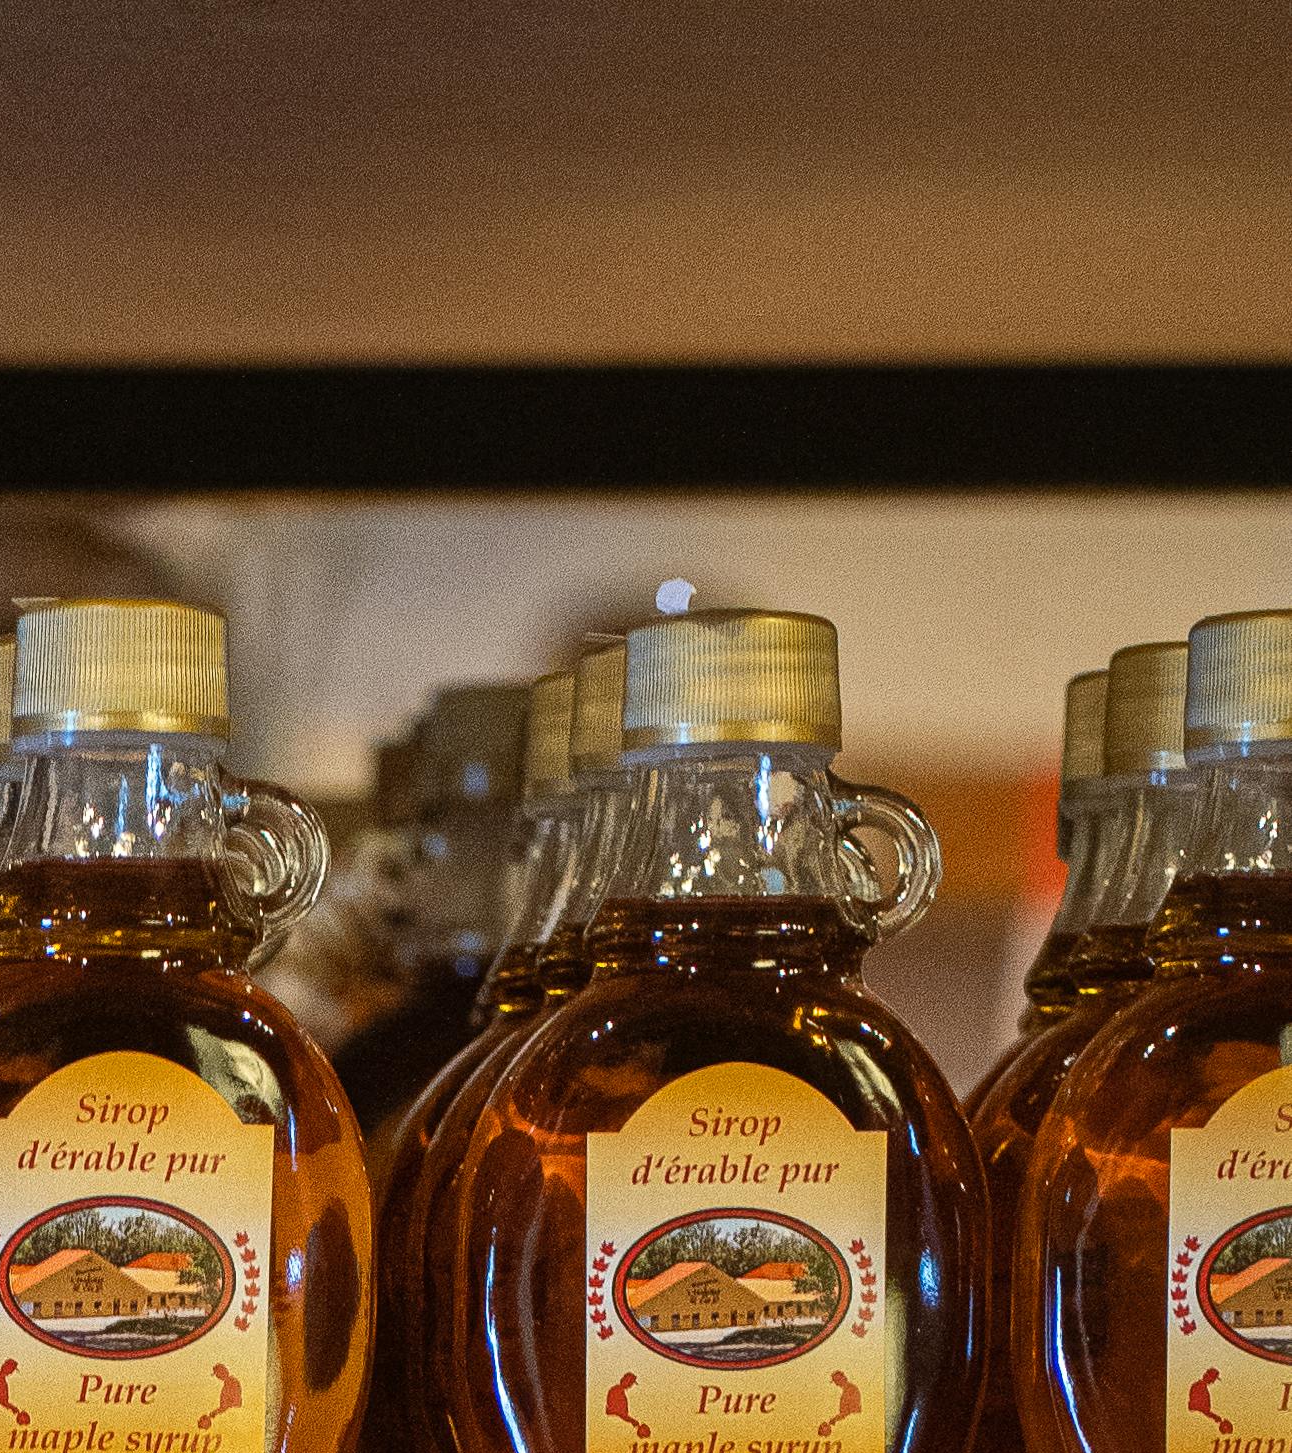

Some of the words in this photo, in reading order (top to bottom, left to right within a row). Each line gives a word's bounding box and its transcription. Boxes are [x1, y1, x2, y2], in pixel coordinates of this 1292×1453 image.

[76, 1092, 169, 1134] Sirop
[688, 1106, 782, 1146] Sirop
[17, 1140, 156, 1172] d'érable
[164, 1149, 226, 1182] pur
[631, 1153, 770, 1185] d'érable
[779, 1160, 839, 1193] pur
[76, 1373, 157, 1405] Pure
[697, 1385, 776, 1415] Pure
